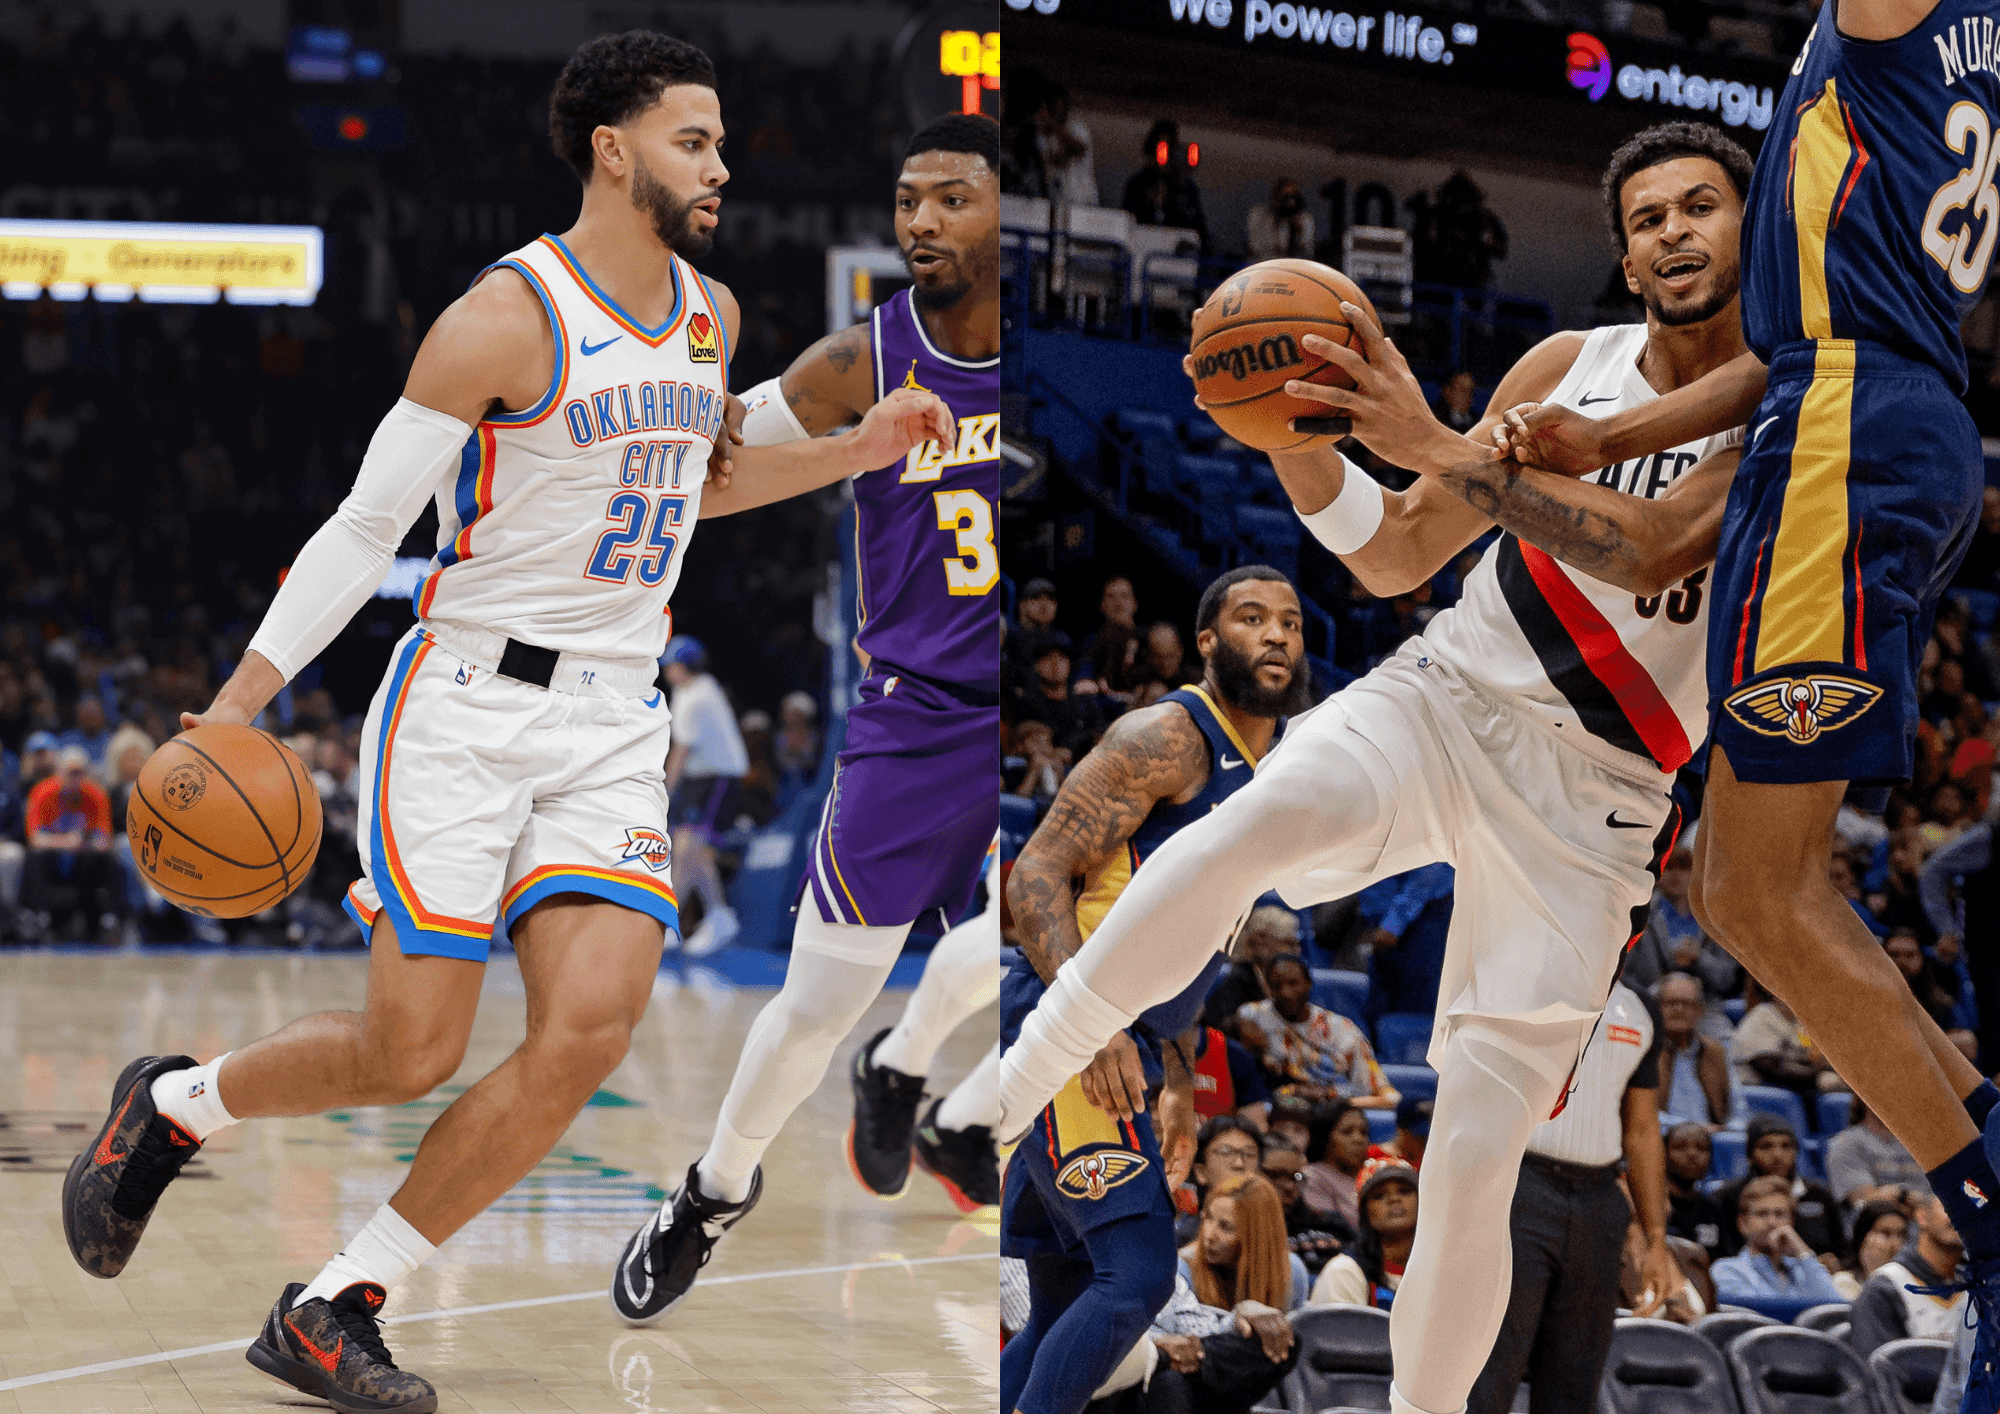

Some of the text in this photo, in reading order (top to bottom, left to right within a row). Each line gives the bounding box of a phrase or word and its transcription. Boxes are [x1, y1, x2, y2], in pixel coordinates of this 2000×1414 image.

[1245, 0, 1375, 50] power
[1382, 10, 1454, 66] life.
[1616, 63, 1774, 131] entergy
[1921, 100, 2000, 294] 25
[691, 344, 717, 359] Love's
[564, 381, 724, 448] OKLAHOMA
[619, 440, 694, 489] CITY
[583, 489, 689, 588] 25
[622, 836, 668, 859] OKC
